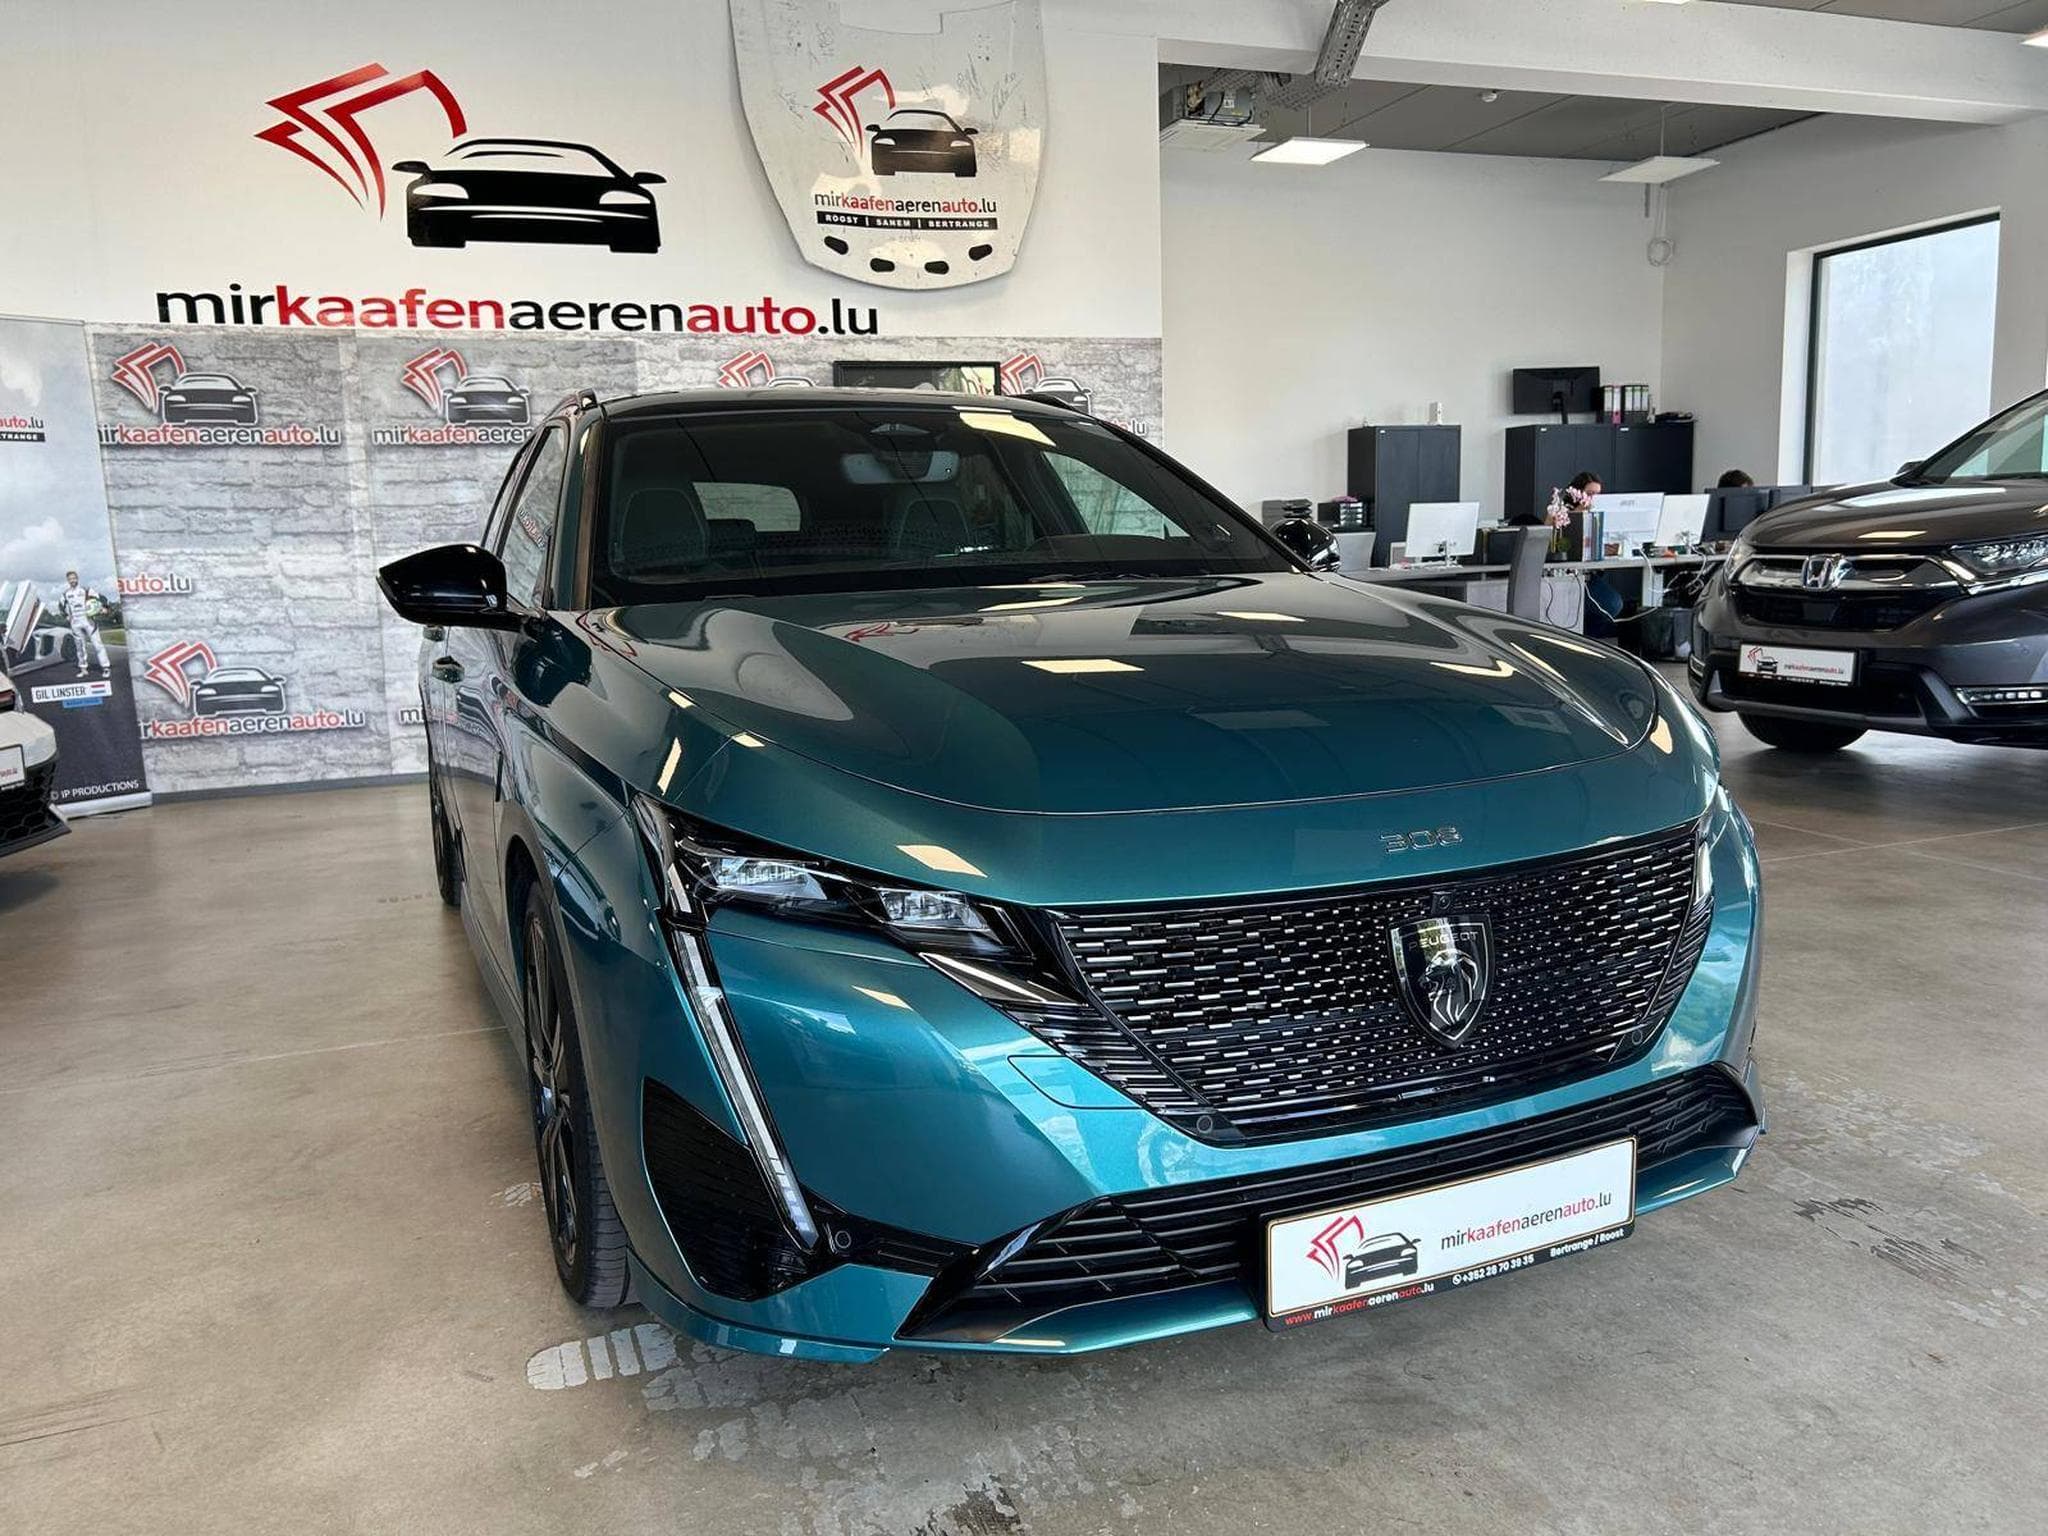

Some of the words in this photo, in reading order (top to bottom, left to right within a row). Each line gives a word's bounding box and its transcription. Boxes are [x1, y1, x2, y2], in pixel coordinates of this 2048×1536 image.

[815, 191, 997, 213] mirkaafenaerenauto.lu
[825, 215, 858, 225] ROOST
[876, 219, 911, 227] SANEM
[928, 220, 989, 228] BERTRANGE
[156, 283, 878, 335] mirkaafenaerenauto.lu
[35, 690, 48, 700] GIL
[51, 686, 86, 699] LINSTER
[140, 709, 364, 738] rkaafenaerenauto.lu
[61, 788, 70, 798] IP
[72, 780, 139, 797] PRODUCTIONS
[1408, 931, 1479, 951] PEUGEOT
[1440, 1192, 1612, 1250] mirkaafenaerenauto.lu
[1499, 1262, 1510, 1273] 70
